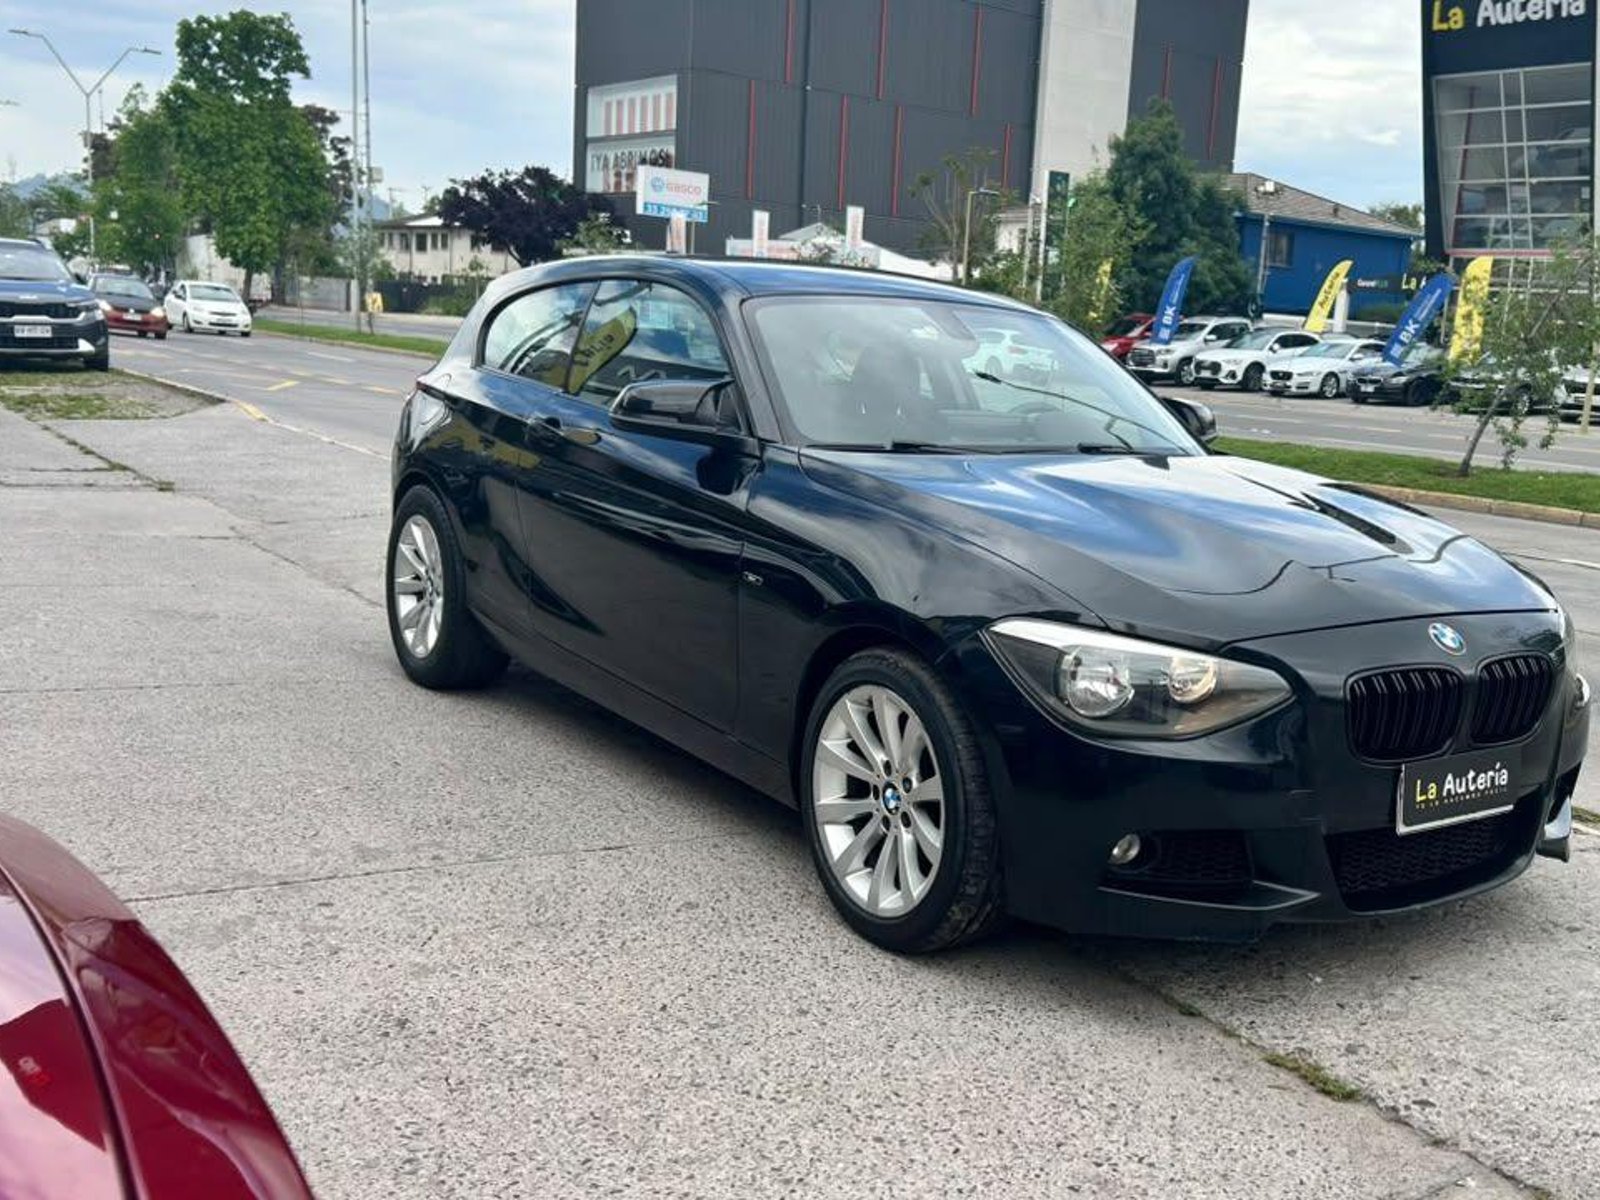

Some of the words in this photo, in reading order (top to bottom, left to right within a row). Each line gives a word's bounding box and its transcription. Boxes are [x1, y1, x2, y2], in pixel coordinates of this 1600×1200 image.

[1432, 0, 1465, 31] La
[1399, 319, 1420, 344] BK
[1416, 779, 1437, 803] La
[1442, 762, 1508, 797] Autería
